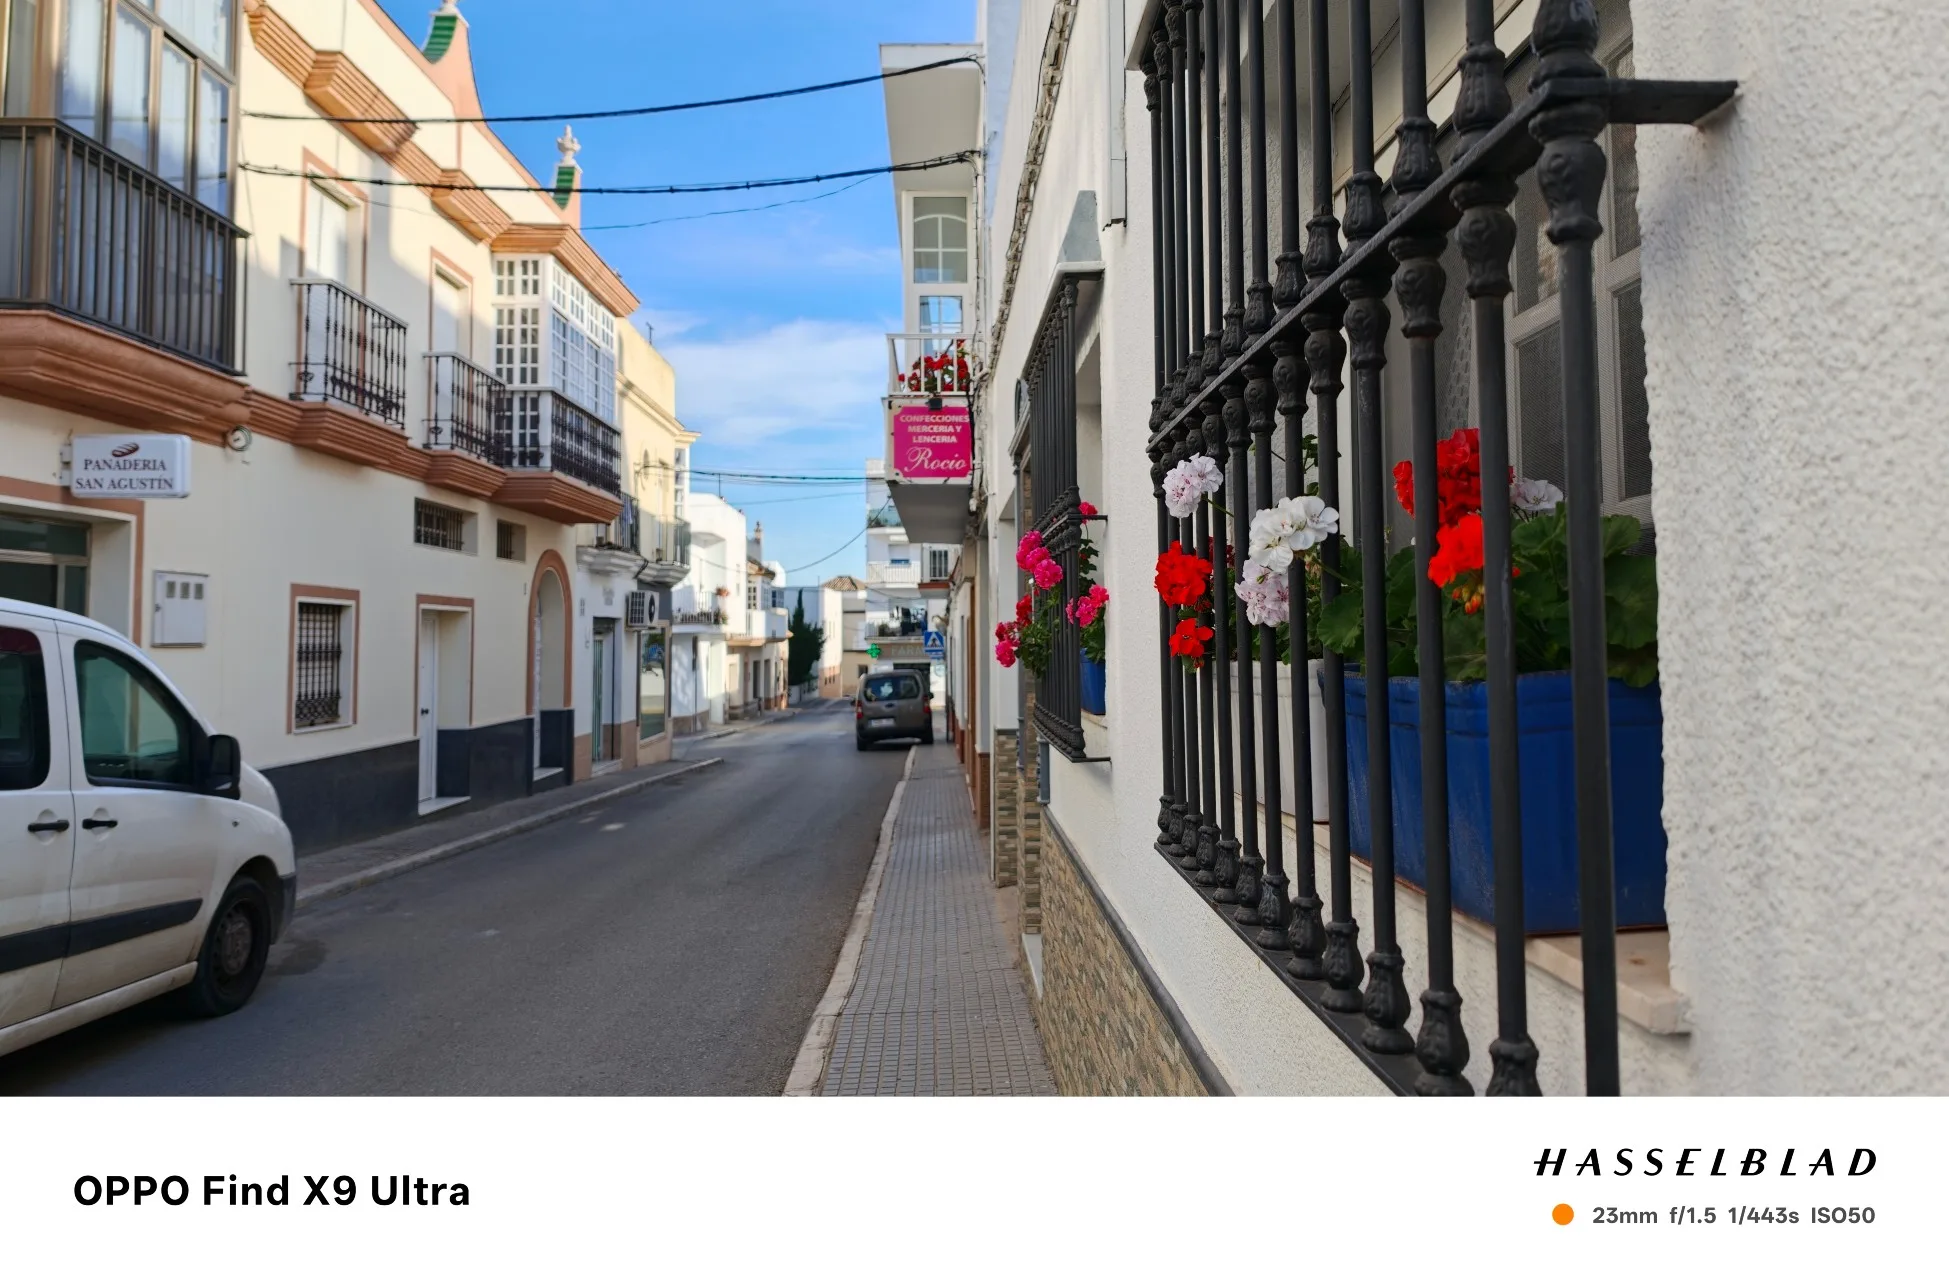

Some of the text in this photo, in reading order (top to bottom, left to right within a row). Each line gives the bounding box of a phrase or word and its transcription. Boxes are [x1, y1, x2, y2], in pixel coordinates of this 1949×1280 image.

[900, 414, 970, 423] CONFECCIONES
[907, 425, 962, 433] MERCERIA Y
[912, 435, 957, 443] LENCERIA
[84, 459, 167, 471] PANADERIA
[76, 475, 174, 490] SAN AGUSTÍN
